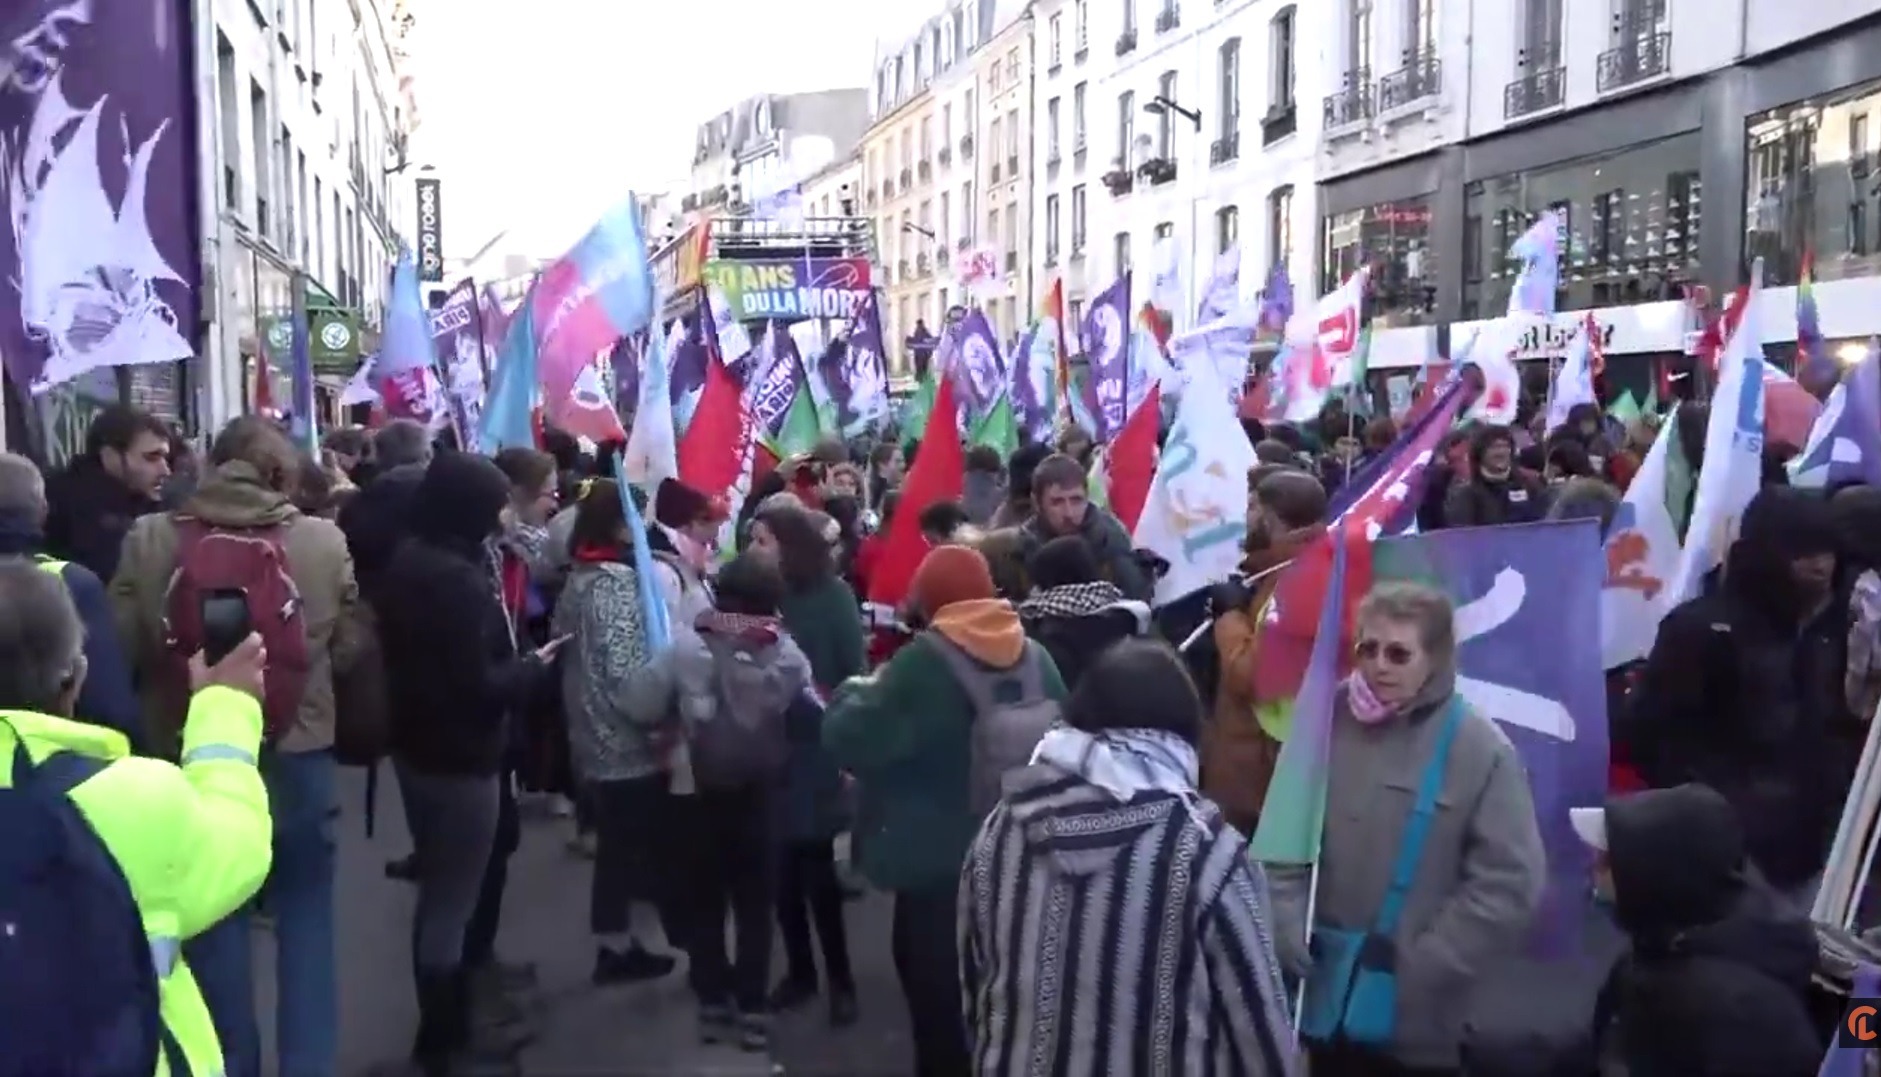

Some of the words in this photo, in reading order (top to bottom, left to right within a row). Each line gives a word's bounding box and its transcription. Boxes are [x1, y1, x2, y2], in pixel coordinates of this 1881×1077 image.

[741, 263, 796, 292] ANS
[742, 292, 771, 314] DU
[773, 291, 797, 313] LA
